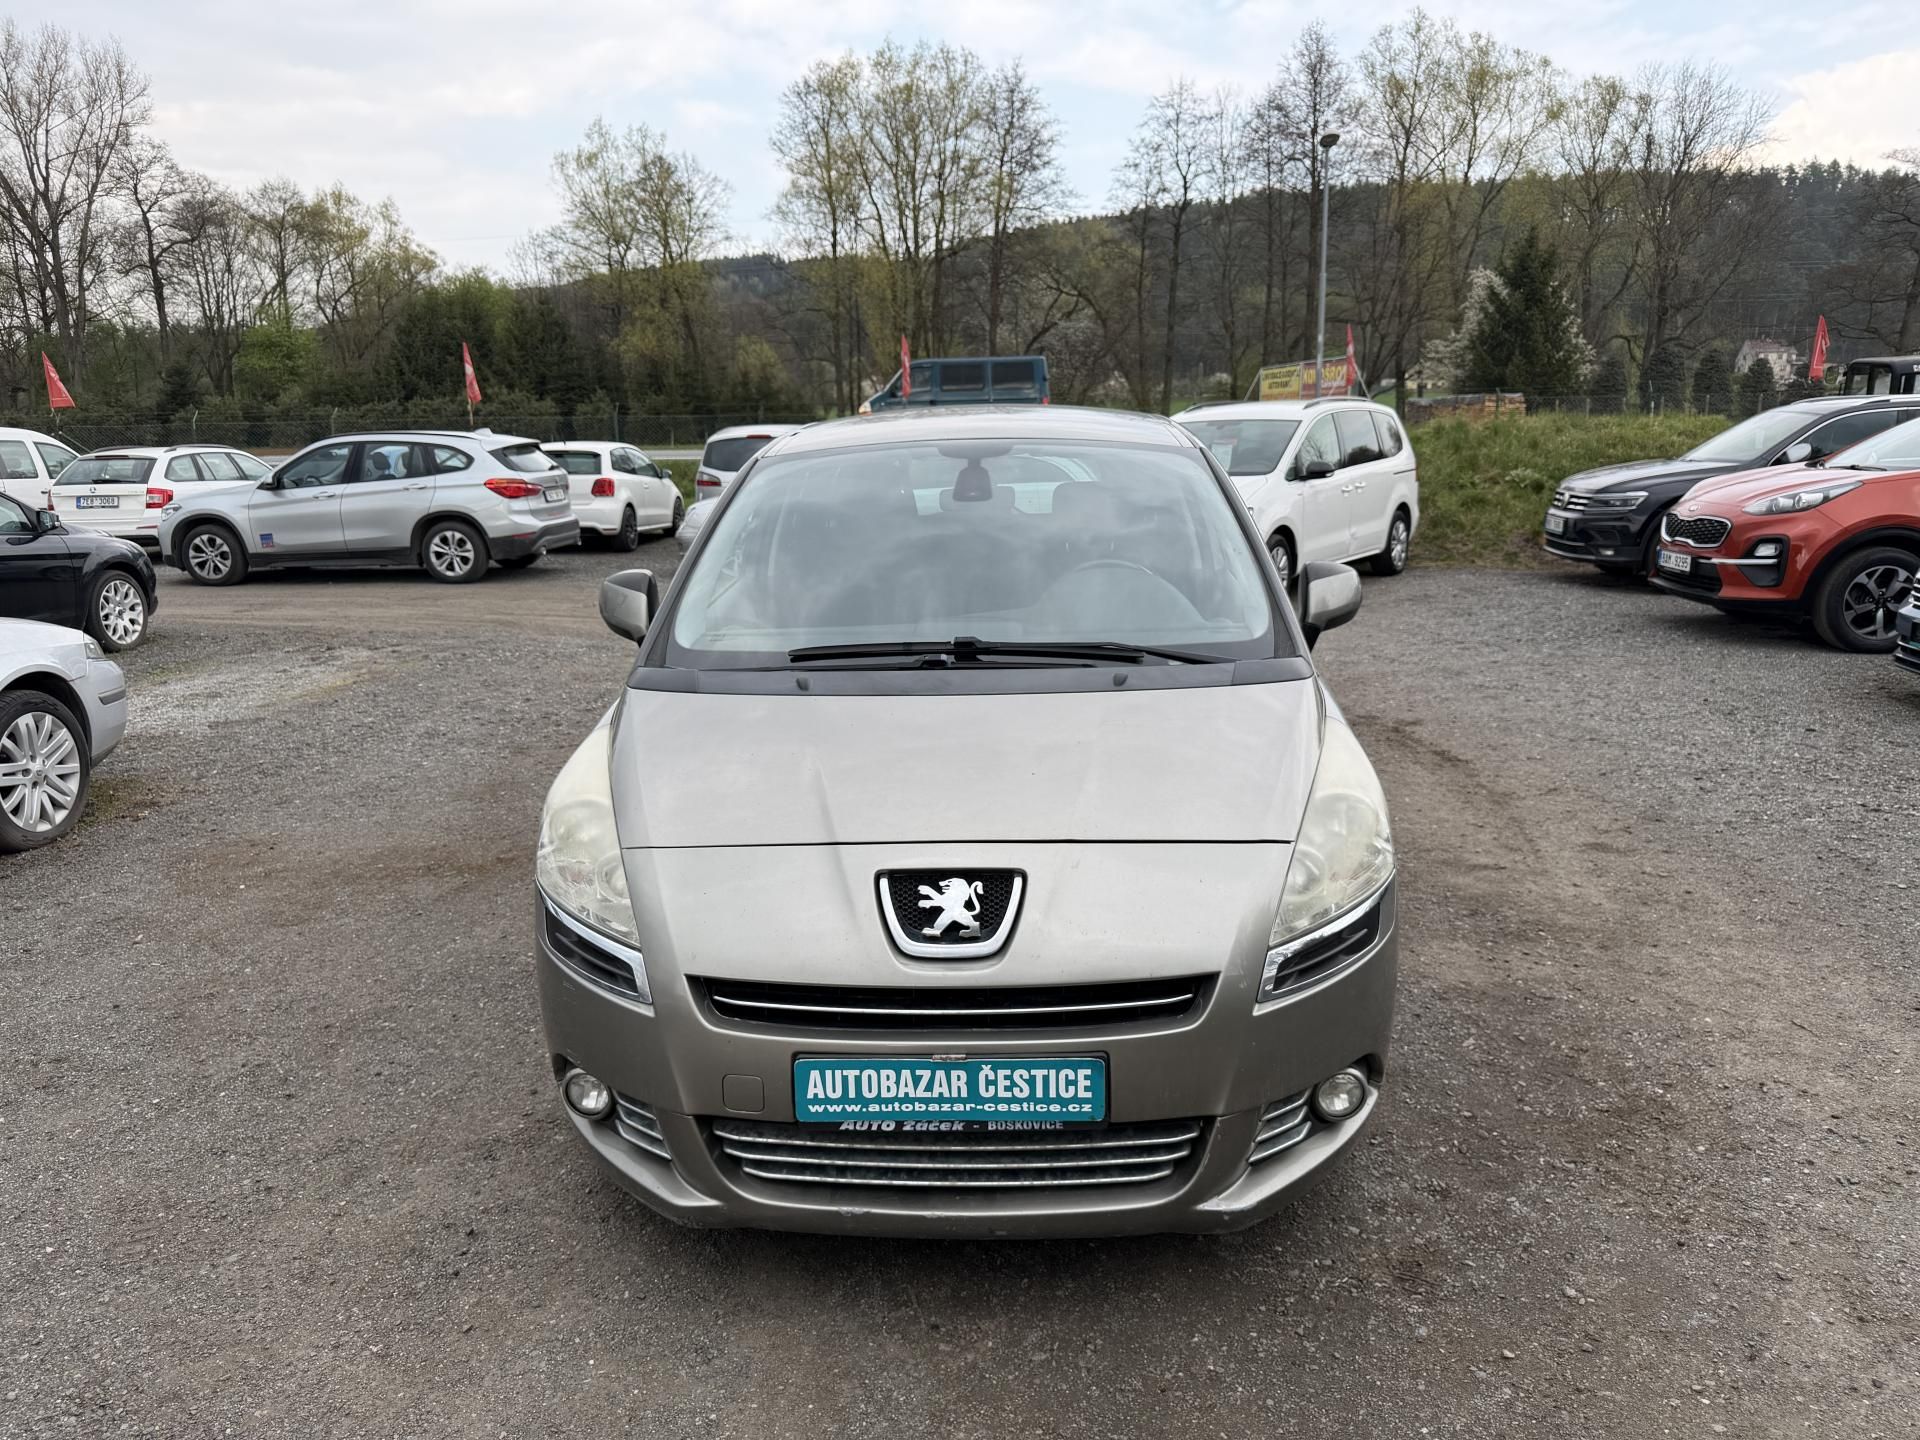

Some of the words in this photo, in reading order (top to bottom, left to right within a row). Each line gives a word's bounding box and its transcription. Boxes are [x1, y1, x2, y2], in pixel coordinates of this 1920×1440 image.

[806, 1069, 968, 1099] AUTOBAZAR
[978, 1064, 1093, 1098] ČESTICE
[807, 1102, 1093, 1113] www.autobazar-cestice.cz
[839, 1120, 896, 1132] AUTO
